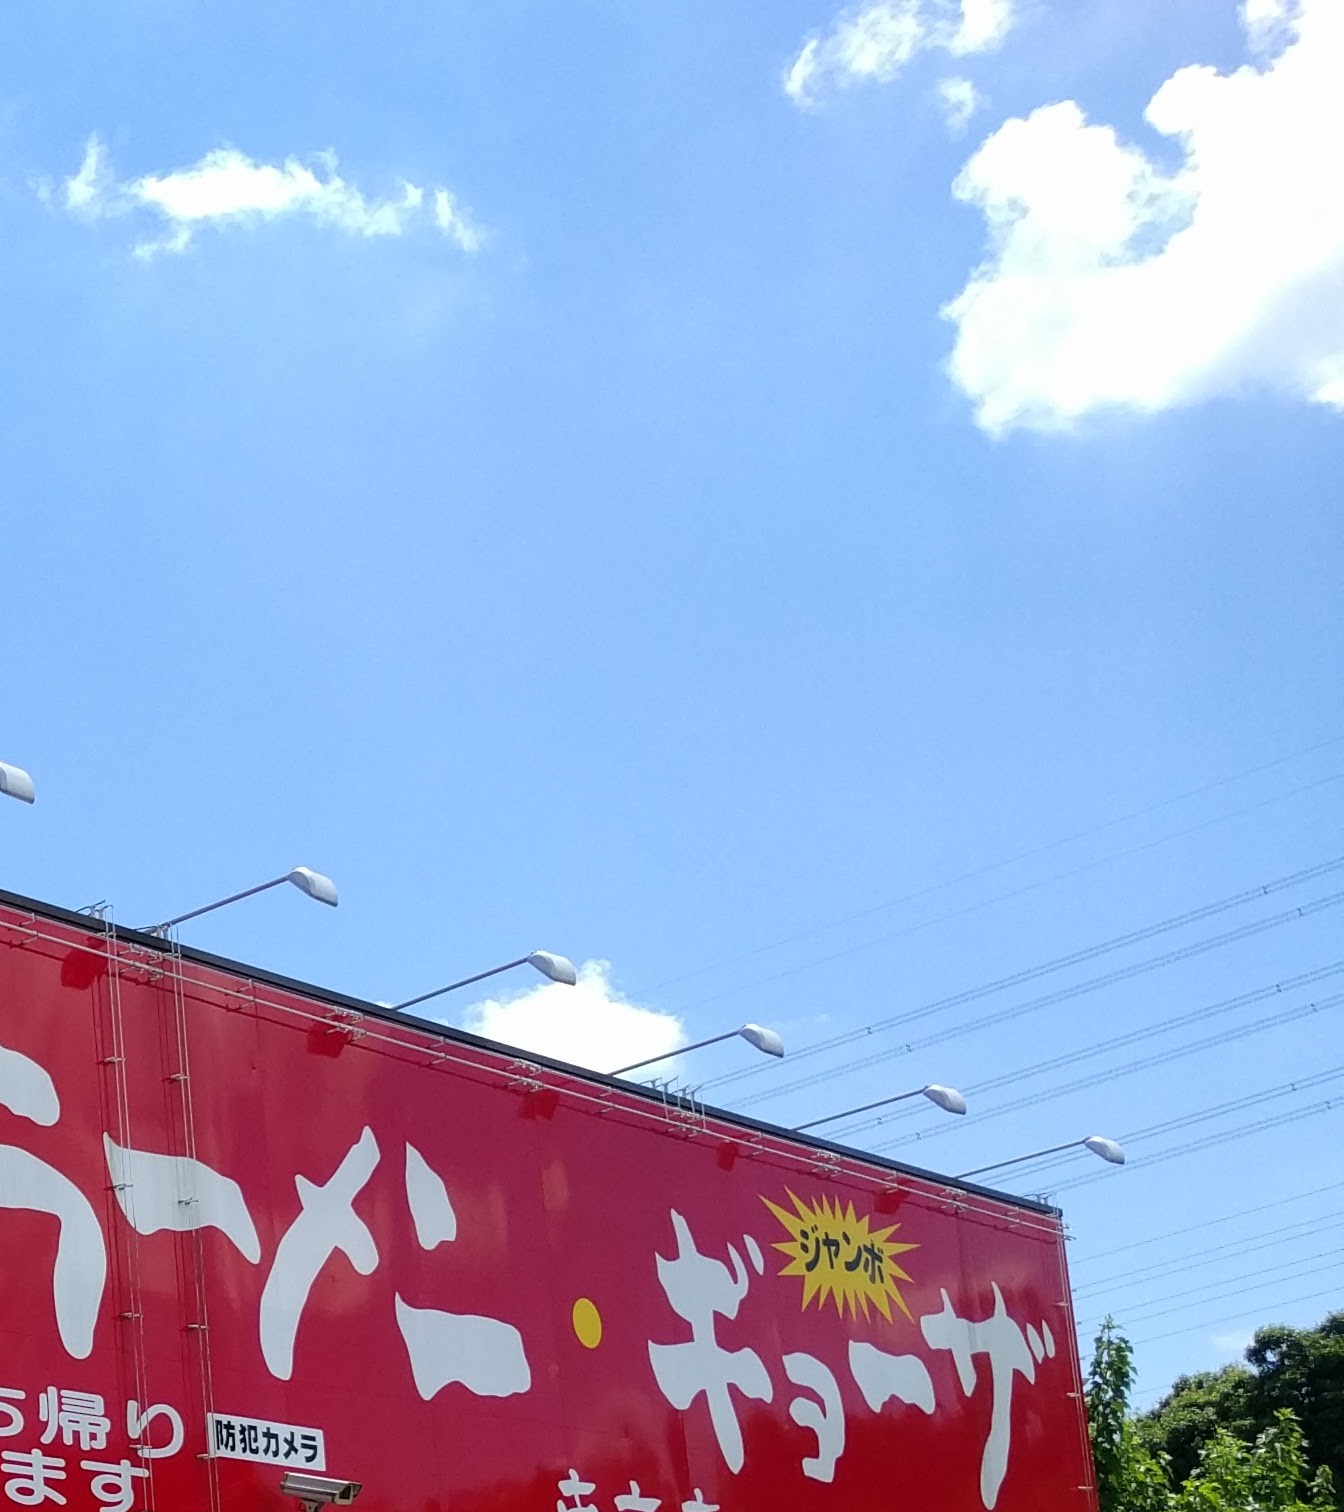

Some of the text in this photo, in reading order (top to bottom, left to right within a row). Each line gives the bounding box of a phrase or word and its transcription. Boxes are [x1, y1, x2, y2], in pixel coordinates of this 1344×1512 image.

[799, 1225, 886, 1284] ジャンボ
[648, 1209, 1056, 1510] ギョーザ
[214, 1418, 320, 1464] 防犯カメラ
